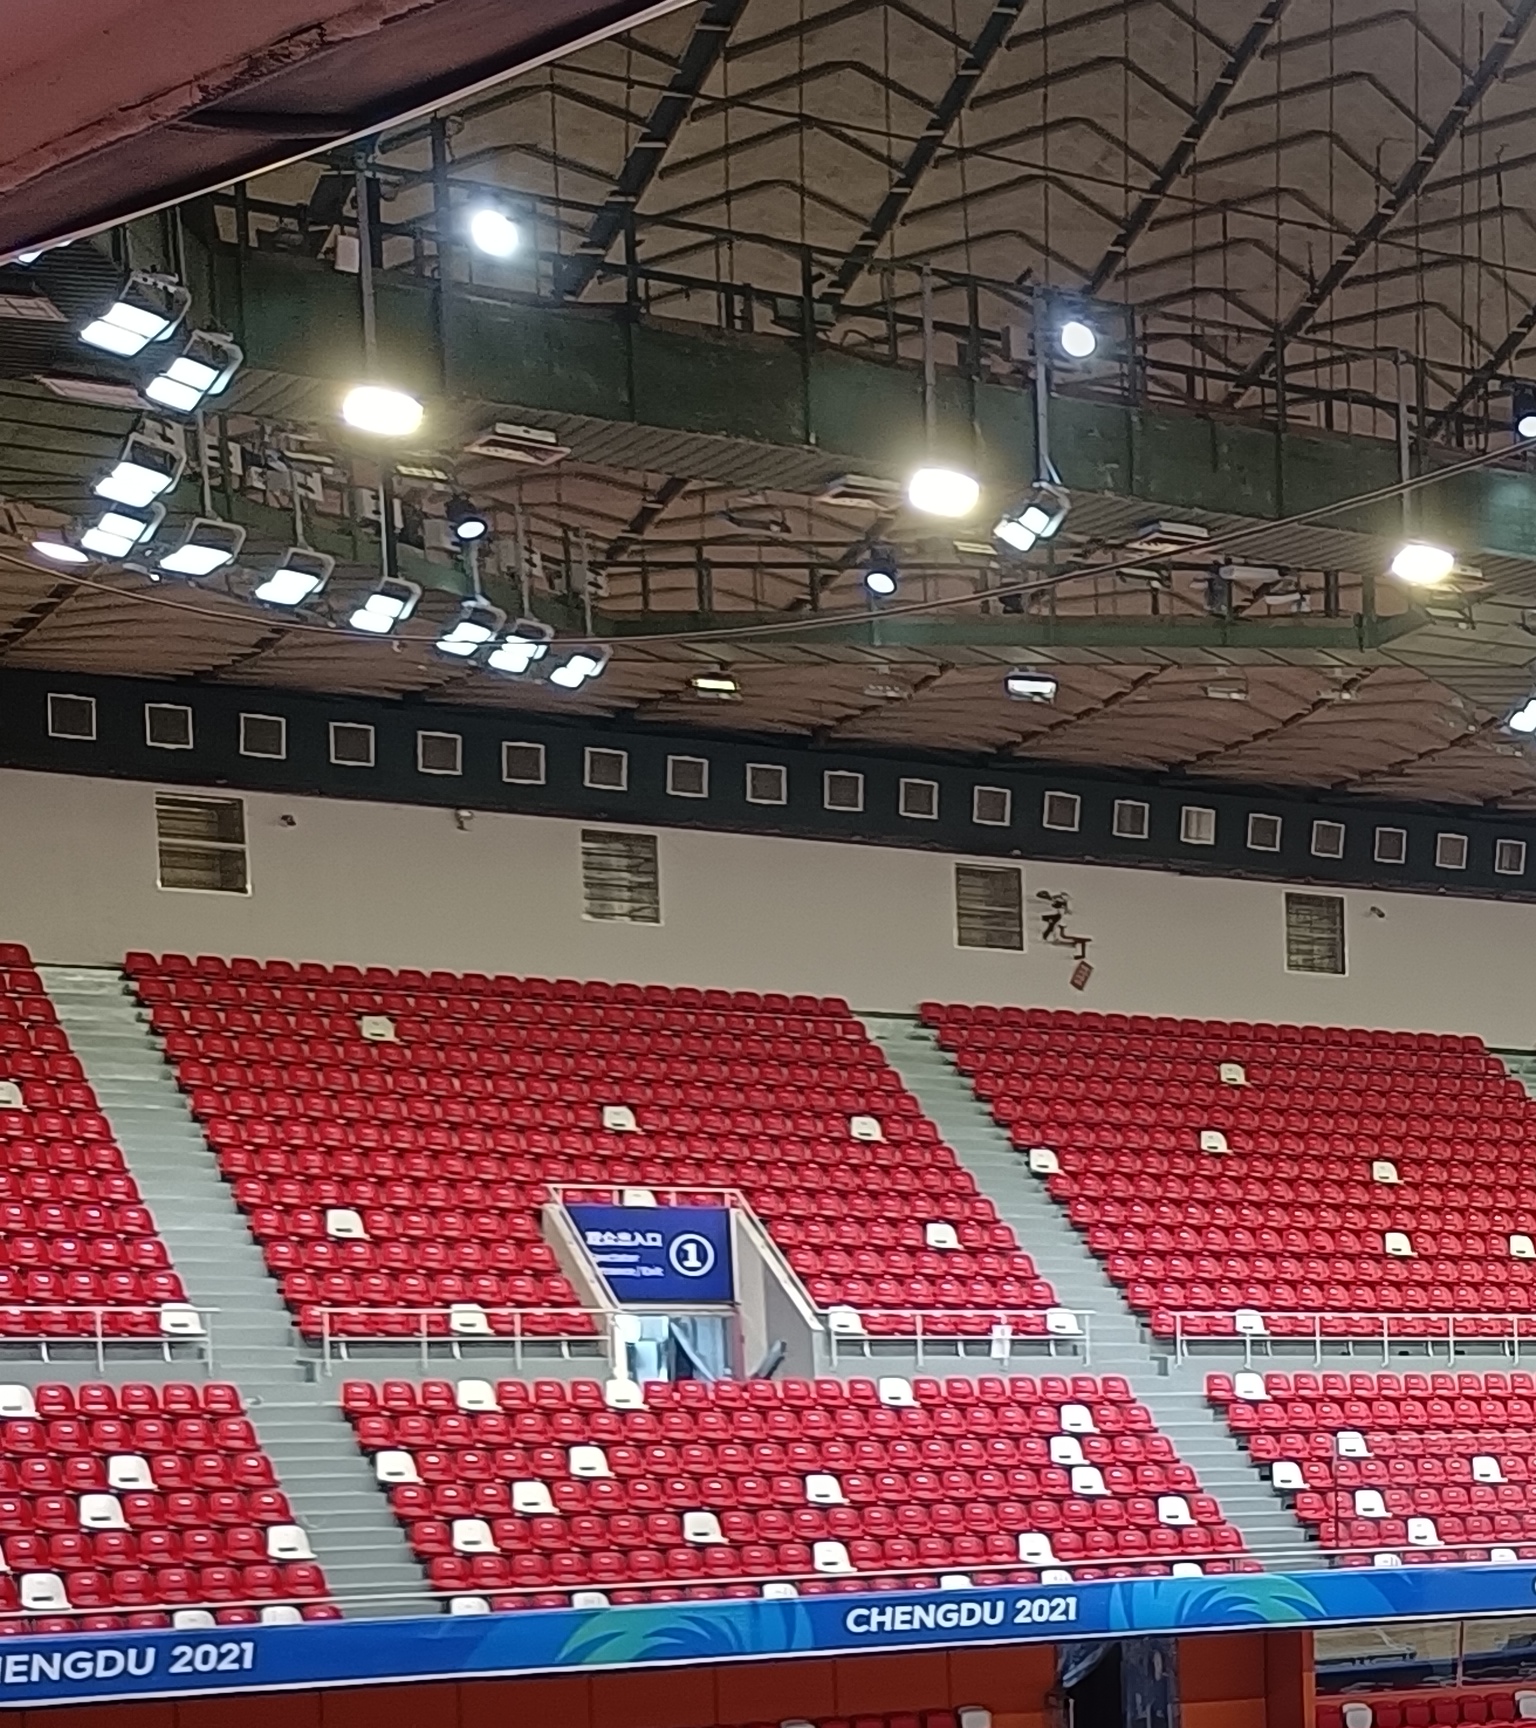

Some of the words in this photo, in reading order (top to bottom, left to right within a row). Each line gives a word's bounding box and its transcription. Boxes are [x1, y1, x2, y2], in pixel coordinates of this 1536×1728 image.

[846, 1600, 1005, 1634] CHENGDU
[1013, 1596, 1078, 1624] 2021
[0, 1646, 156, 1684] ENGDU
[168, 1641, 255, 1674] 2021
